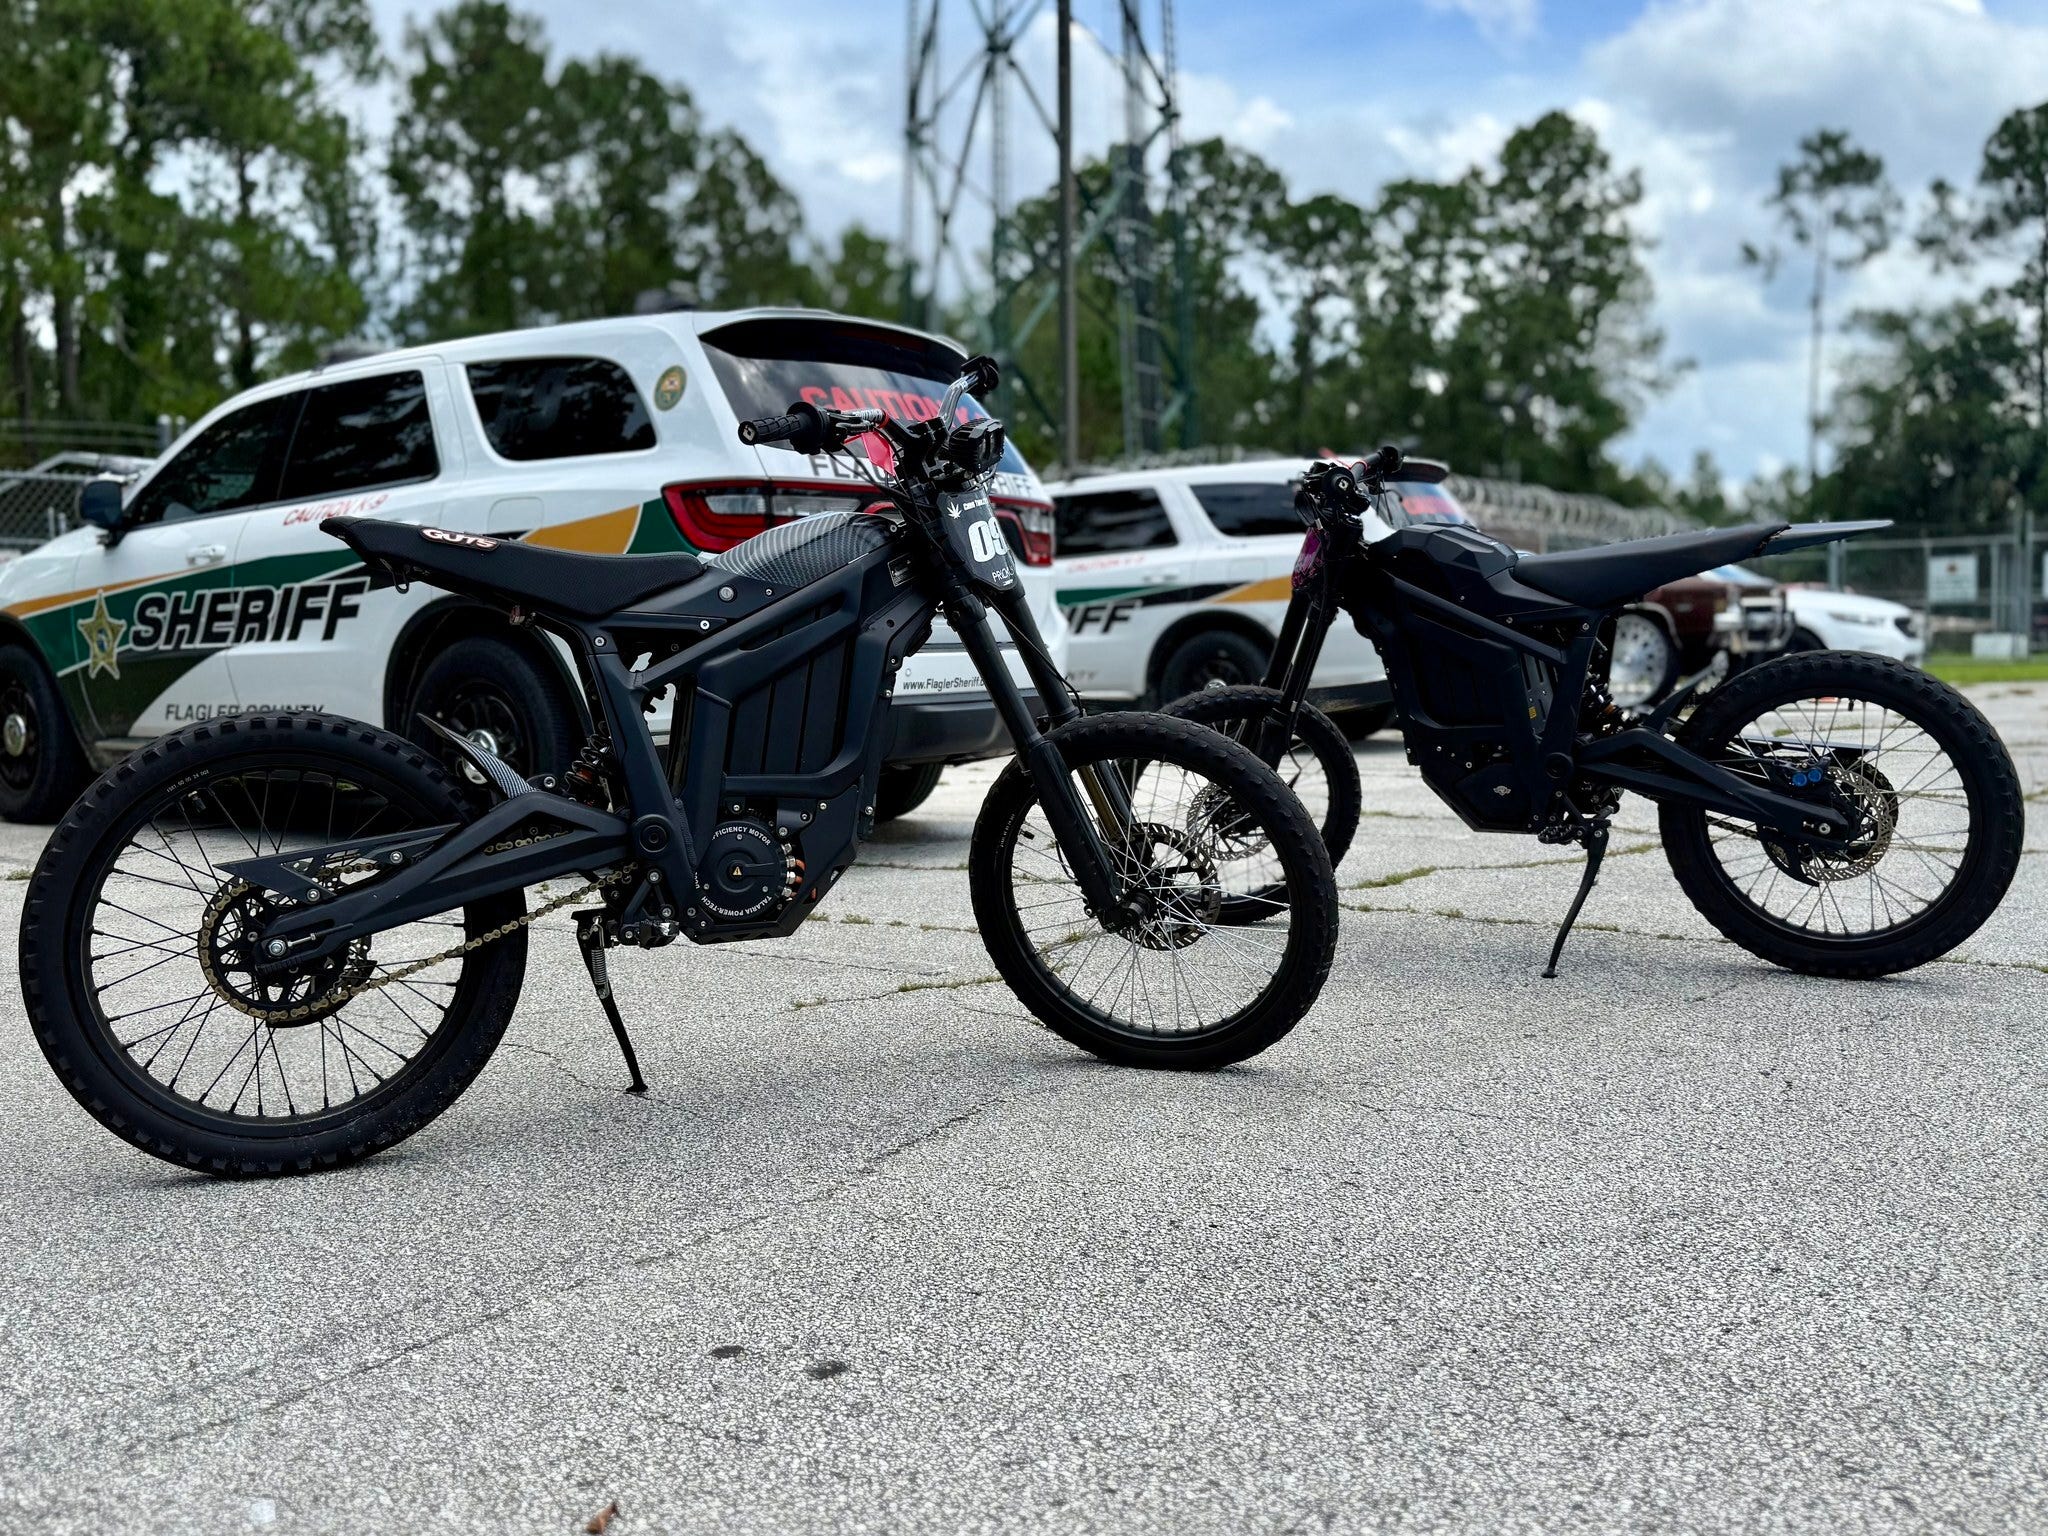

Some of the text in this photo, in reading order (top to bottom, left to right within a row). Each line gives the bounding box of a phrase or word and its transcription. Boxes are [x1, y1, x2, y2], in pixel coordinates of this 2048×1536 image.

[283, 500, 352, 526] CAUTION
[422, 528, 497, 548] GUTS
[968, 517, 1008, 563] 09
[130, 577, 370, 651] SHERIFF
[903, 677, 986, 692] www.FlaglerSheriff.c
[749, 828, 771, 846] MOTOR
[701, 895, 772, 917] TALARIA POWER-TECH
